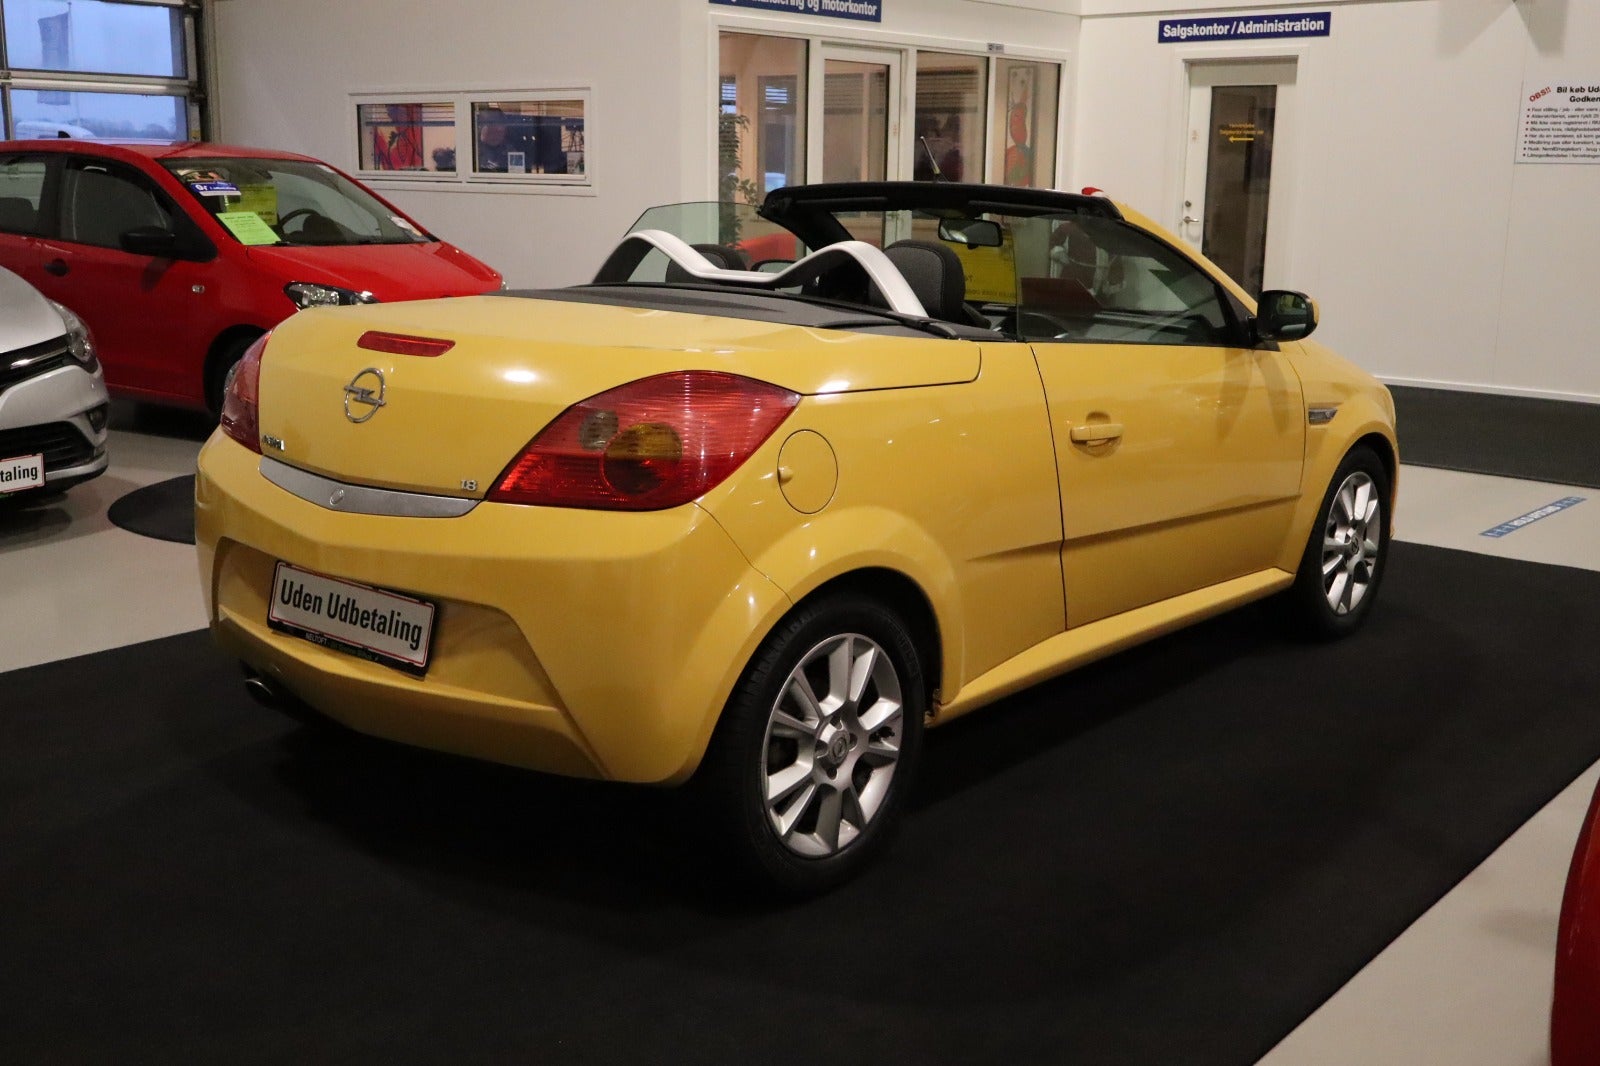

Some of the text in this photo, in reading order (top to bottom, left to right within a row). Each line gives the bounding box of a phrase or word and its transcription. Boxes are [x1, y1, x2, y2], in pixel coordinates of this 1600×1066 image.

[807, 0, 820, 12] og
[821, 1, 877, 16] motorkontor
[1163, 23, 1229, 39] Salgskontor
[1237, 18, 1324, 34] Administration
[1529, 86, 1551, 102] OBS!!
[280, 579, 422, 651] Uden Udbetaling
